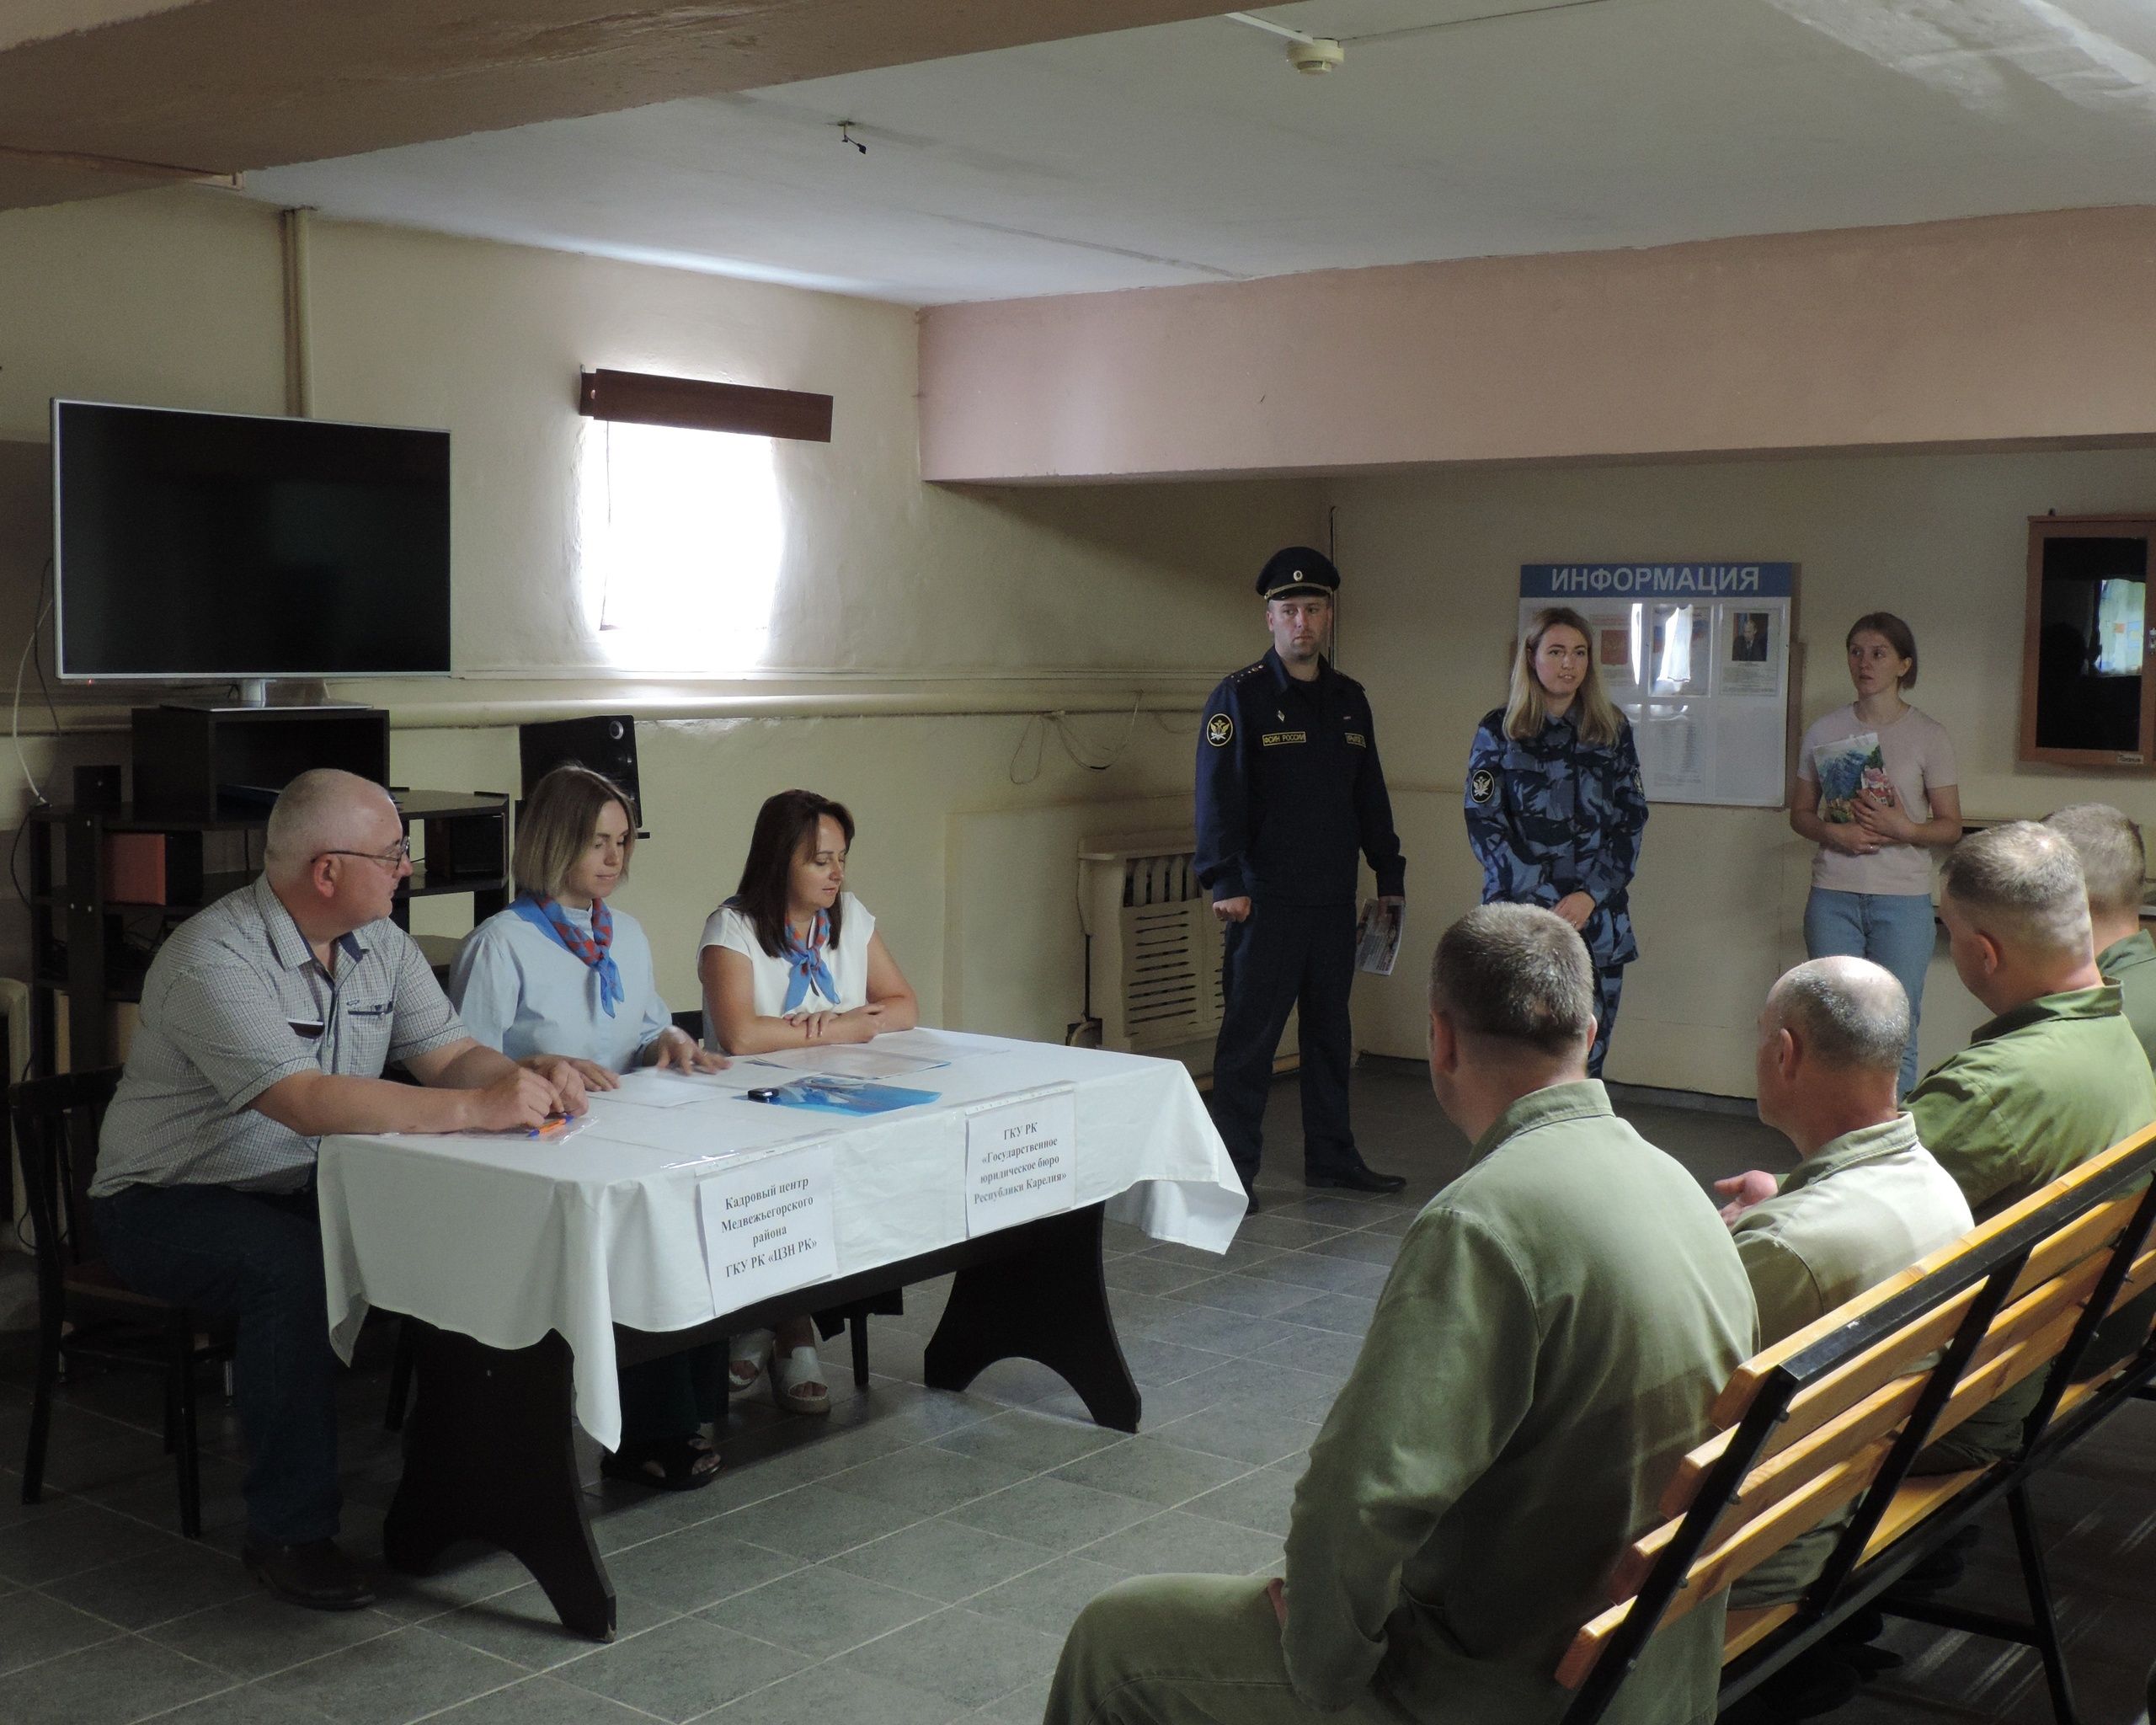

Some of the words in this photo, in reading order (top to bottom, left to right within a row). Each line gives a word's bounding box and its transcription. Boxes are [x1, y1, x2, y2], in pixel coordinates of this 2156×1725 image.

[1551, 567, 1759, 595] ИНФОРМАЦИЯ
[1282, 734, 1305, 742] РОССИИ
[1004, 1125, 1023, 1140] ГКУ
[1025, 1122, 1038, 1135] РК
[982, 1138, 1058, 1163] «Государственное
[980, 1162, 1036, 1184] юридическое
[1038, 1156, 1059, 1168] бюро
[725, 1184, 776, 1210] Кадровый
[779, 1178, 808, 1194] центр
[974, 1183, 1024, 1204] Республики
[1027, 1172, 1067, 1189] Карелия»
[721, 1196, 814, 1233] Медвежьегорского
[752, 1226, 787, 1247] района
[726, 1259, 748, 1278] ГКУ
[751, 1254, 766, 1268] РК
[768, 1244, 795, 1263] «ЦЗН
[798, 1238, 817, 1252] РК»
